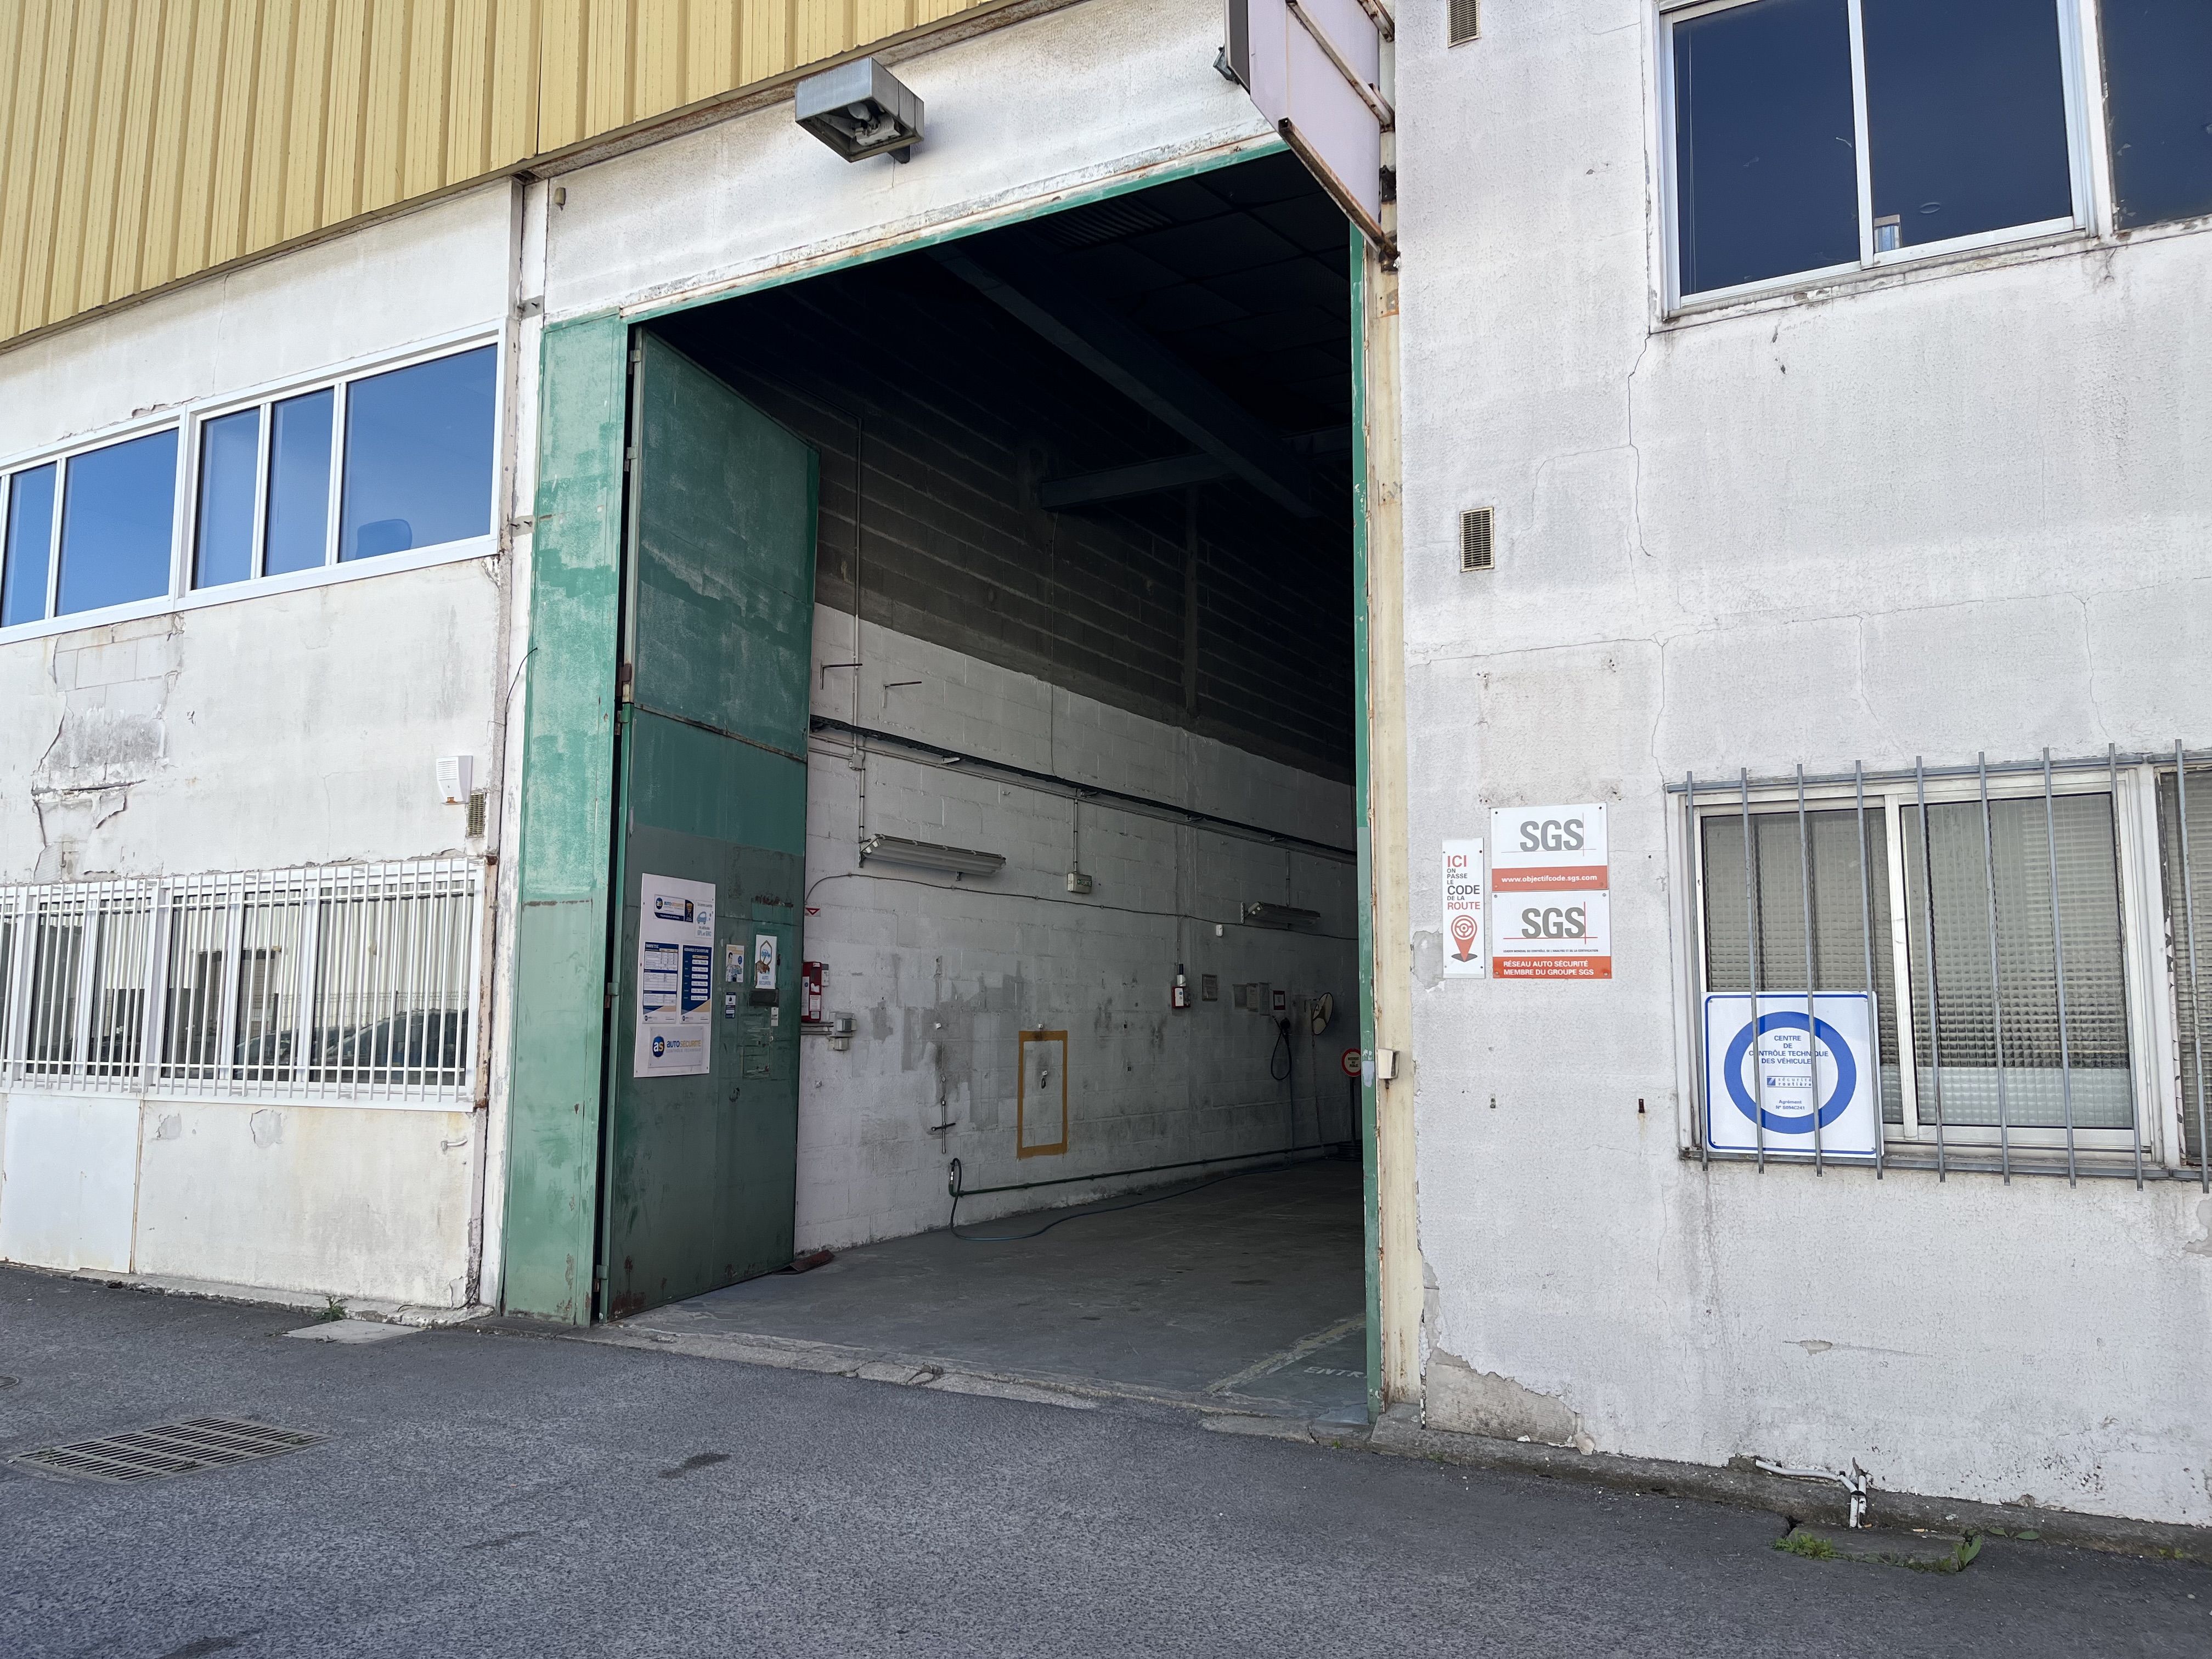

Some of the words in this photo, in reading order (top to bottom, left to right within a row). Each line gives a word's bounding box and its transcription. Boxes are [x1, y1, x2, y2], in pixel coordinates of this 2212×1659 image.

[1520, 819, 1584, 851] SGS
[1447, 855, 1467, 867] ICI
[1501, 874, 1598, 883] www.objectifcode.sgs.com
[1447, 885, 1480, 895] CODE
[1447, 901, 1481, 910] ROUTE
[1521, 907, 1585, 938] SGS
[1554, 959, 1589, 967] SÉCURITÉ
[1304, 1366, 1367, 1379] ENTR
